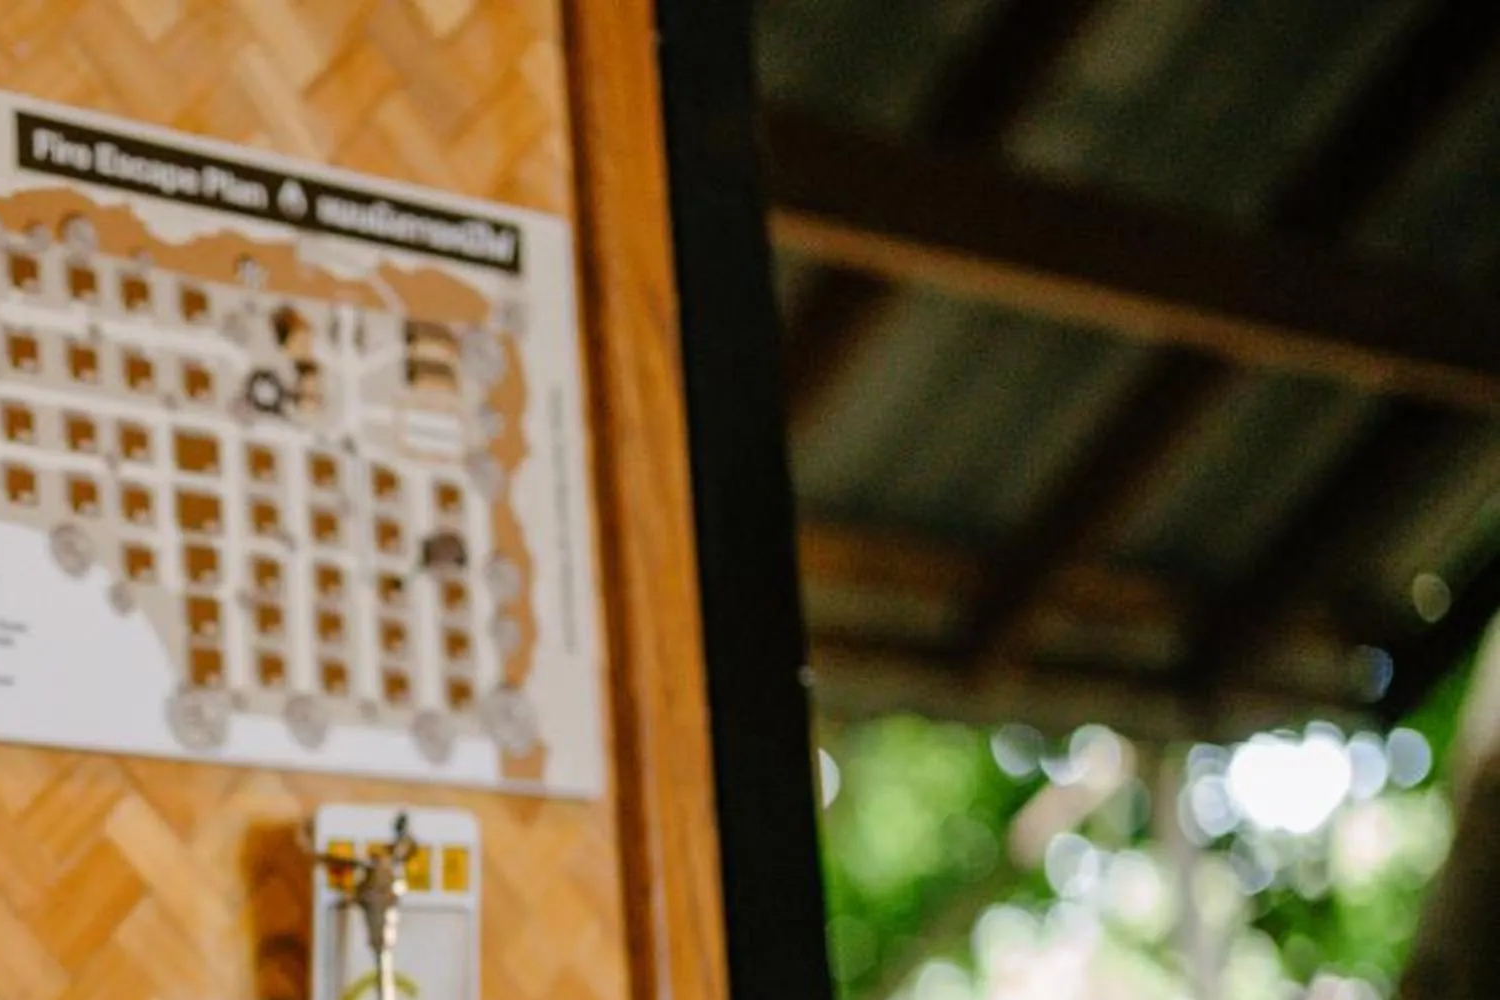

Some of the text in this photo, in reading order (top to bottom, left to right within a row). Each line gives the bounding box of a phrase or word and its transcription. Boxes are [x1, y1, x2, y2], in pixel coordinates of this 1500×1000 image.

[32, 127, 269, 209] Fire Escape Plan
